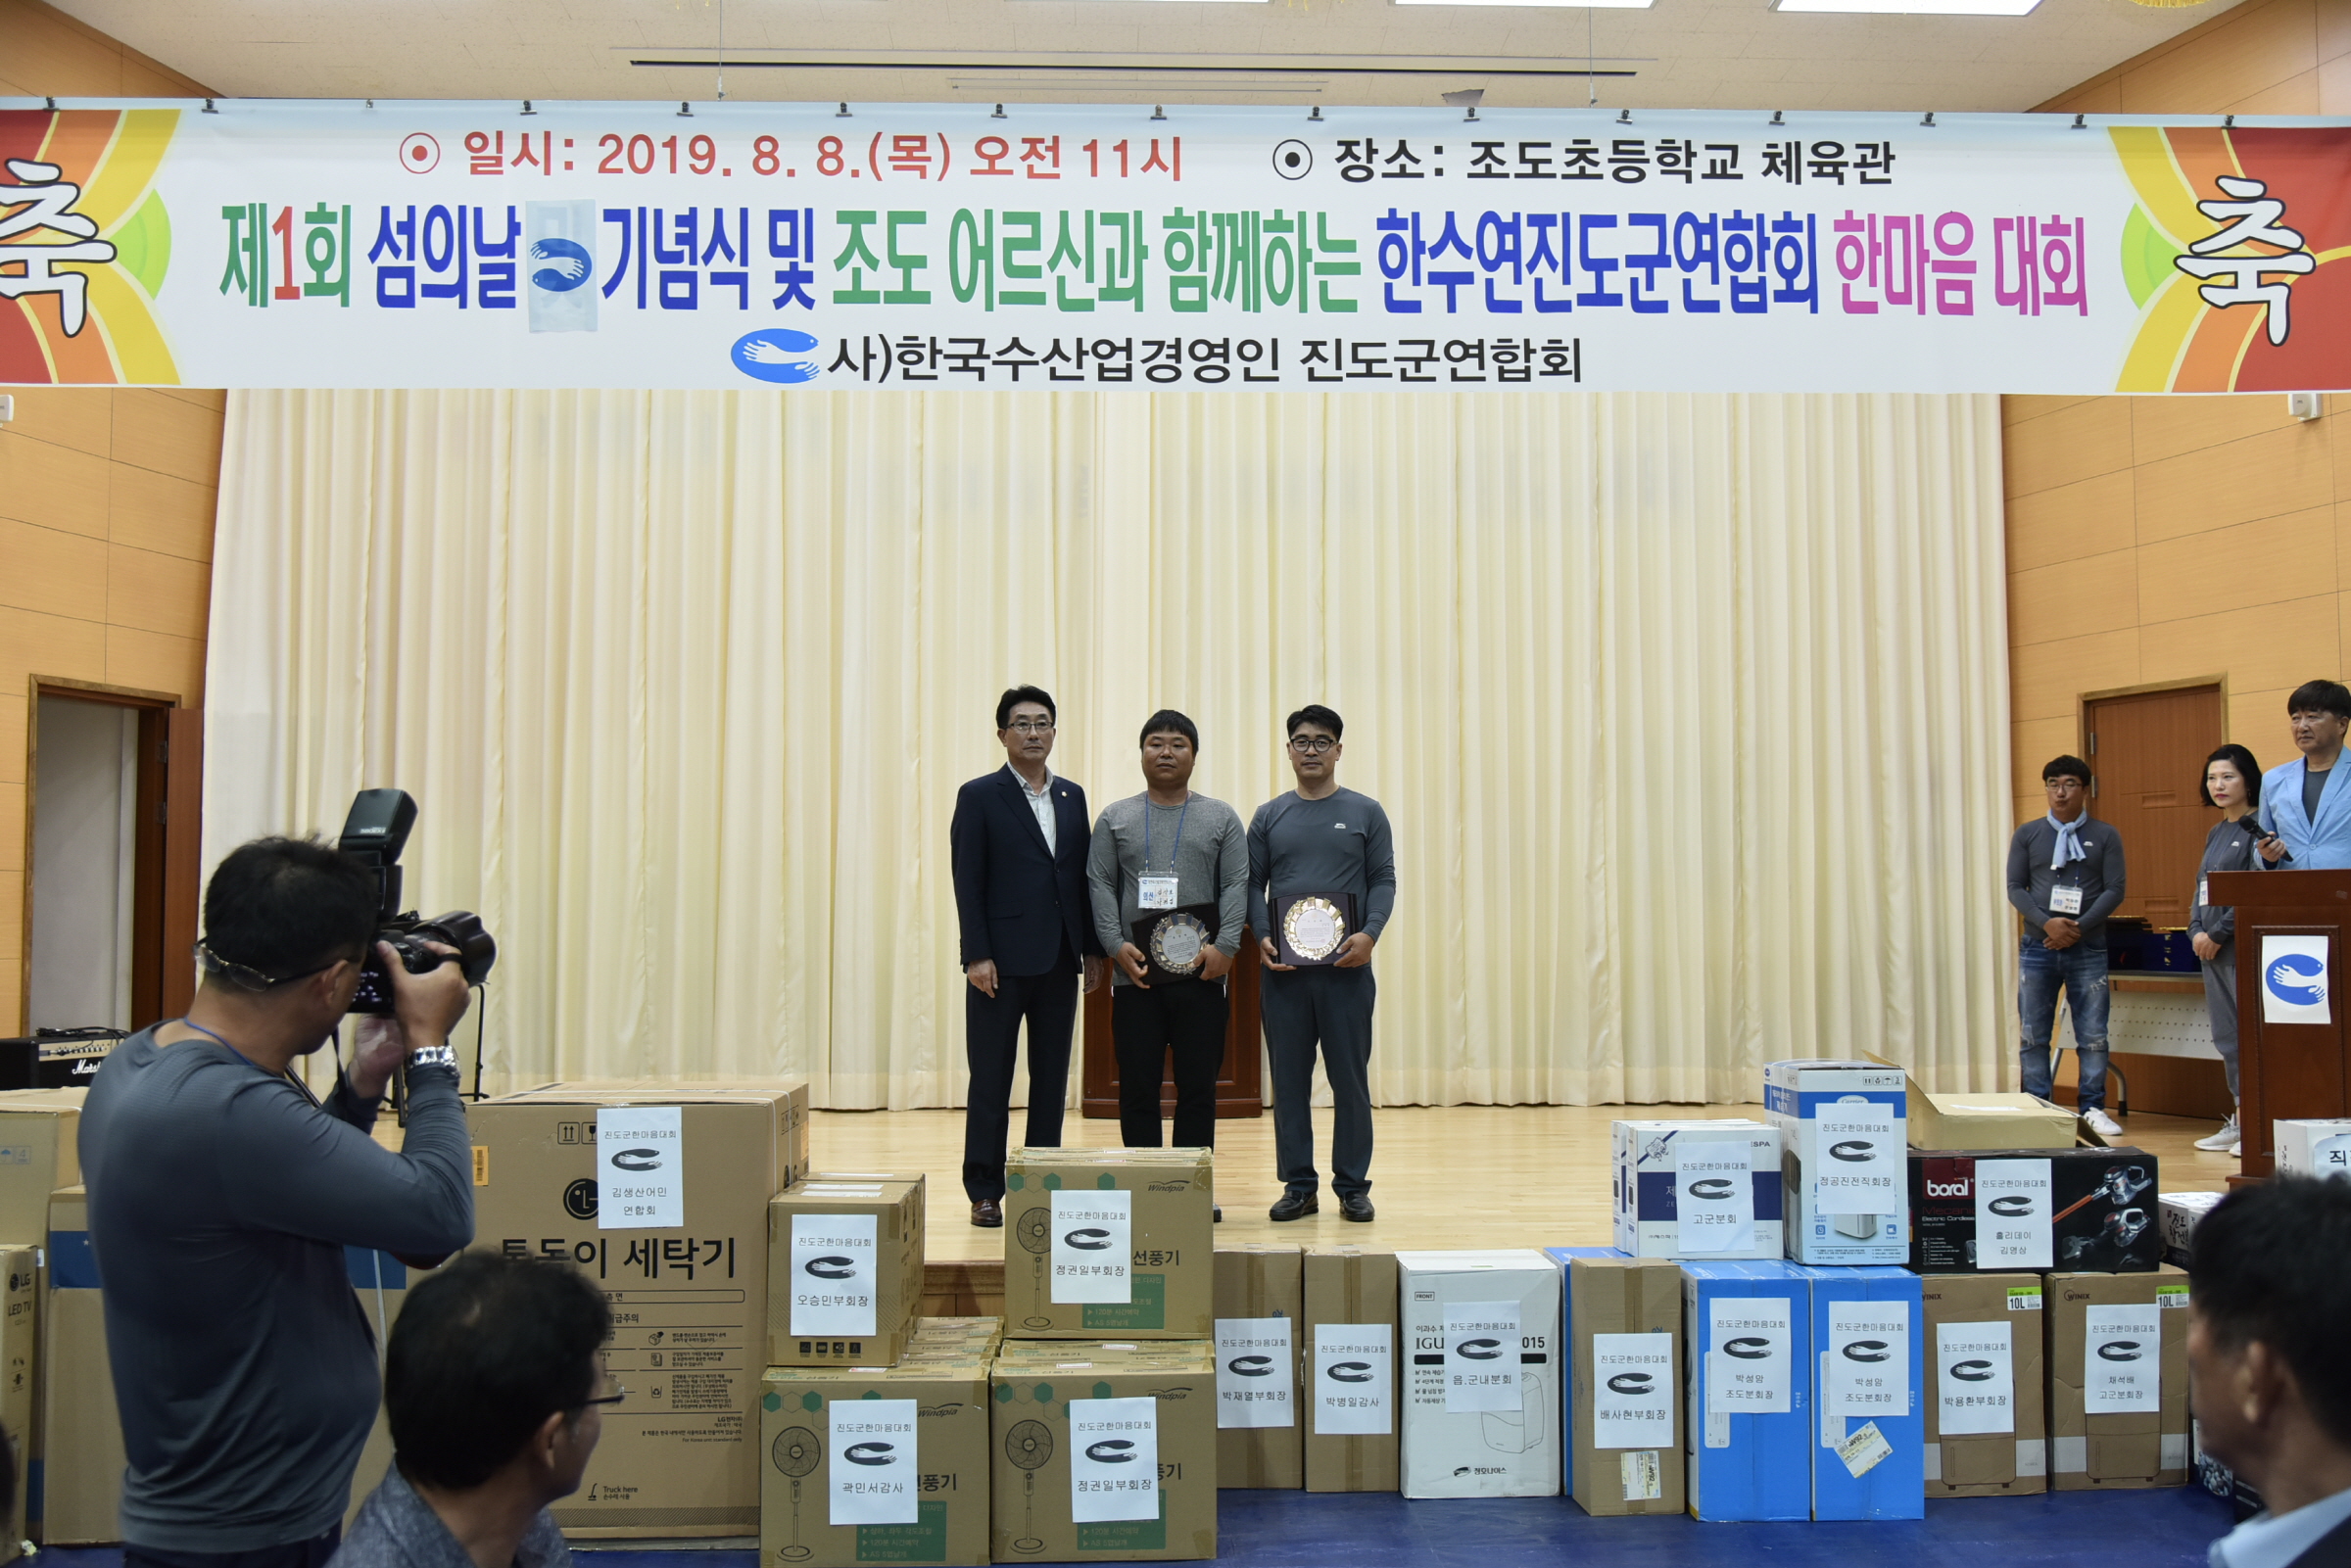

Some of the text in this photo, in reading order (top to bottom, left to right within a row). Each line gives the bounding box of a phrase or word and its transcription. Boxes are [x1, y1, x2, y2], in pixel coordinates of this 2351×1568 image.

[464, 130, 576, 177] 일시:
[598, 133, 733, 177] 2019.
[970, 135, 1061, 180] 오전
[1082, 136, 1181, 182] 11시
[1334, 139, 1897, 185] 장소: 조도초등학교 체육관
[0, 158, 118, 338] 축
[219, 202, 2089, 317] 제1회 섬의날 기념식 및 조도 어르신과 함께하는 한수연진도군연합회 한마음 대회
[2174, 174, 2317, 347] 축
[827, 333, 1583, 384] 사)한국수산업경영인 진도군연합회
[1822, 1123, 1890, 1133] 진도군한마음대회
[604, 1129, 677, 1139] 진도군한마음대회
[2328, 1149, 2351, 1166] 직
[1820, 1176, 1892, 1187] 정공진전직회장
[1981, 1179, 2047, 1188] 진도군한마음대회
[612, 1187, 667, 1198] 김생산어민
[1147, 1183, 1185, 1194] Windpia
[1927, 1179, 1969, 1197] boral
[623, 1206, 656, 1215] 연합회
[1058, 1211, 1127, 1220] 진도군한마음대회
[1693, 1213, 1737, 1224] 고군분회
[798, 1237, 872, 1247] 진도군한마음대회
[623, 1237, 735, 1280] 세탁기
[1132, 1250, 1180, 1267] 선풍기
[1055, 1264, 1126, 1277] 정권일부회장
[796, 1295, 869, 1307] 오승민부회장
[2009, 1297, 2026, 1309] 10L
[2157, 1295, 2175, 1307] 10L
[1450, 1321, 1516, 1331] 진도군한마음대회
[1716, 1319, 1786, 1329] 진도군한마음대회
[1835, 1322, 1904, 1332] 진도군한마음대회
[2091, 1324, 2155, 1333] 진도군한마음대회
[1221, 1339, 1287, 1348] 진도군한마음대회
[1943, 1342, 2007, 1353] 진도군한마음대회
[1320, 1345, 1387, 1354] 진도군한마음대회
[1600, 1354, 1668, 1364] 진도군한마음대회
[1735, 1373, 1764, 1384] 박성암
[1854, 1377, 1883, 1387] 박성암
[1725, 1390, 1774, 1401] 조도분회장
[1845, 1393, 1893, 1402] 조도분회장
[2098, 1390, 2143, 1401] 고군분회장
[837, 1423, 912, 1433] 진도군한마음대회
[1078, 1421, 1152, 1431] 진도군한마음대회
[602, 1485, 639, 1494] Truck here
[841, 1482, 904, 1495] 곽민서감사
[1077, 1478, 1152, 1493] 정권일부회장
